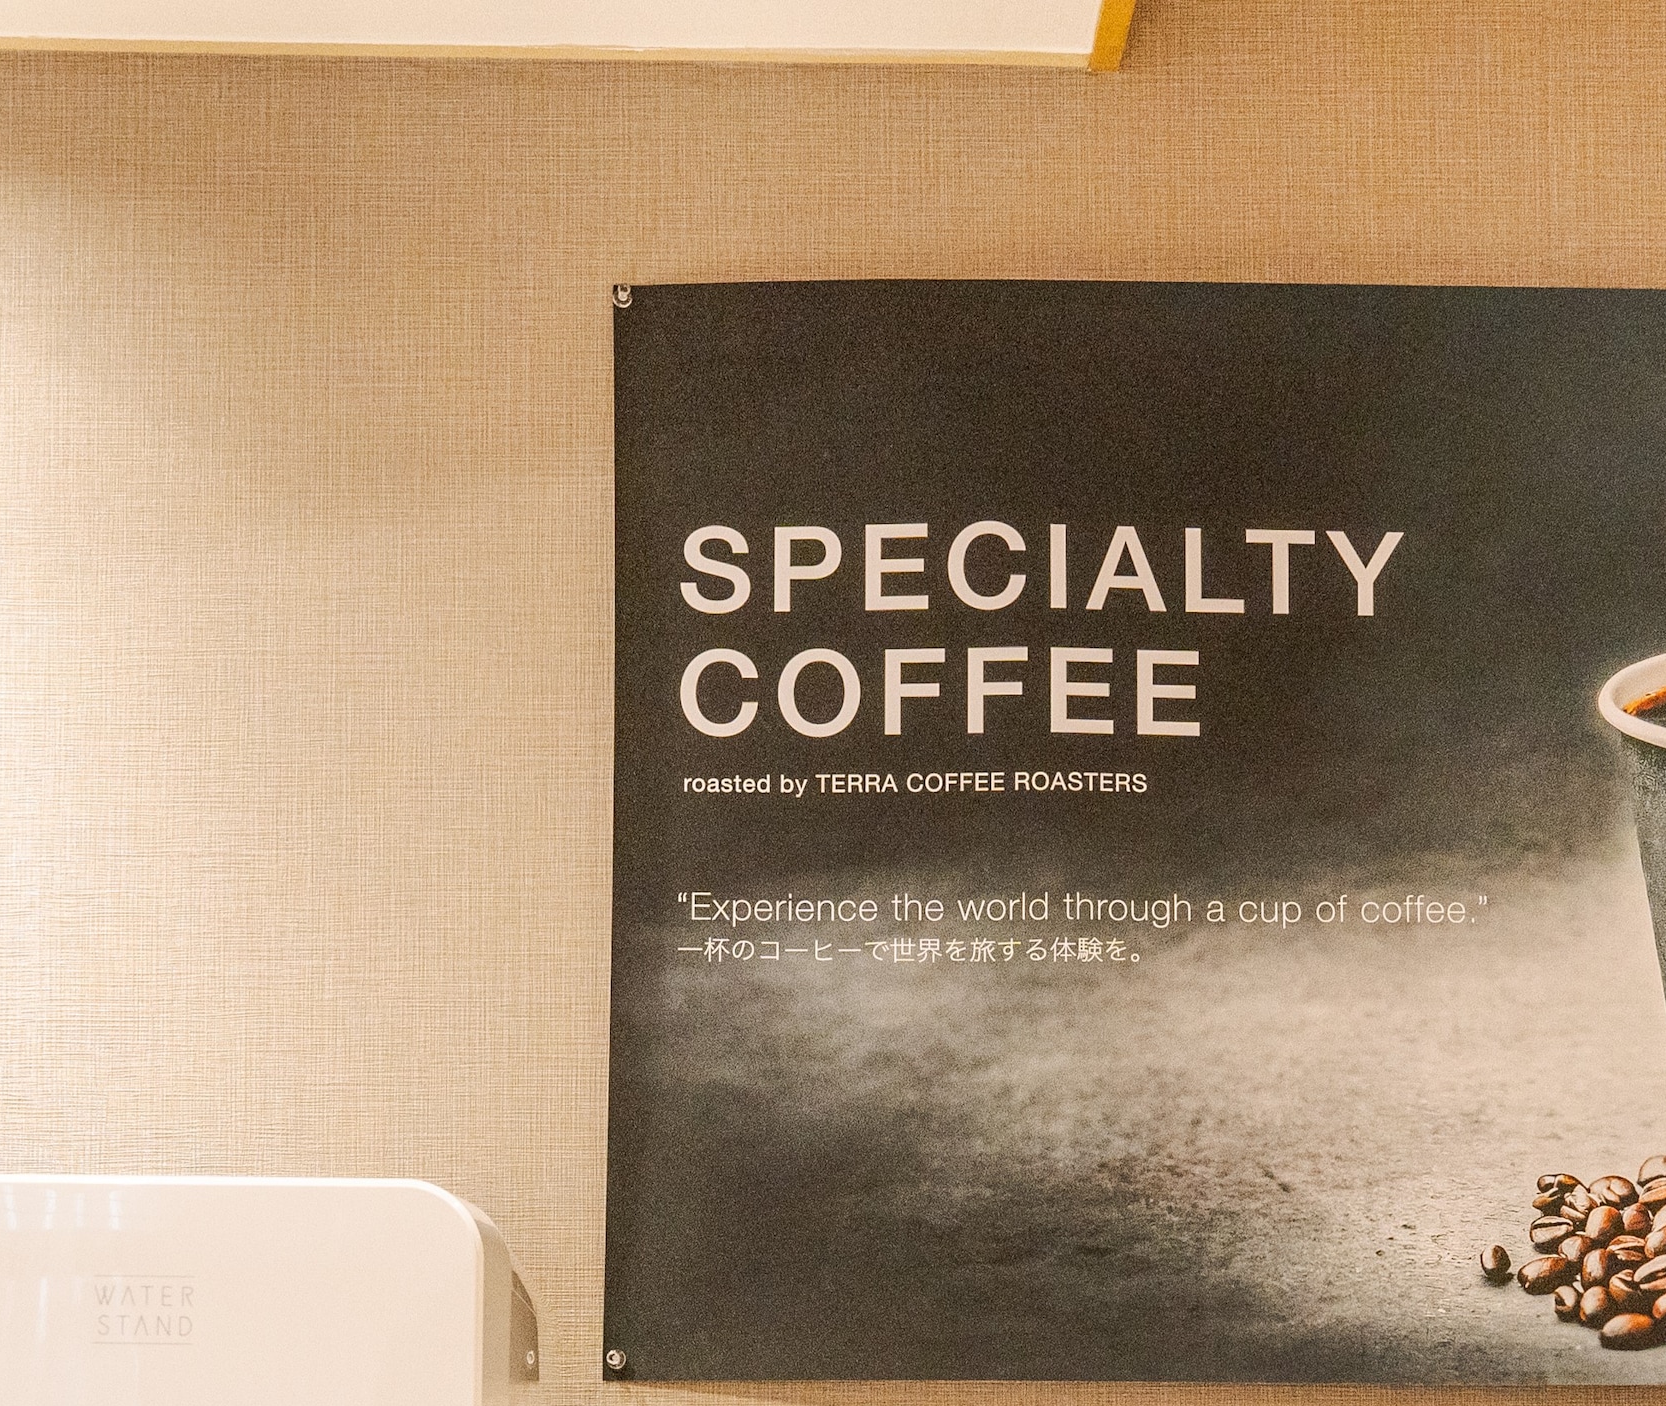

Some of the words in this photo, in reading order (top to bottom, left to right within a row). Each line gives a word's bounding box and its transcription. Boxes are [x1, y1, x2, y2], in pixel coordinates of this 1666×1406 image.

[679, 520, 1405, 617] SPECIALTY
[679, 646, 1201, 738] COFFEE
[683, 774, 771, 793] roasted
[779, 774, 808, 798] by
[815, 773, 898, 794] TERRA
[906, 771, 1006, 793] COFFEE
[1014, 771, 1148, 793] ROASTERS
[677, 891, 878, 928] “Experience
[891, 893, 945, 923] the
[958, 892, 1050, 923] world
[1063, 892, 1192, 929] through
[1206, 900, 1226, 923] a
[1238, 899, 1302, 930] cup
[1315, 895, 1348, 923] of
[1360, 894, 1489, 925] coffee.”
[677, 936, 1141, 964] 一杯のコーヒーで世界を旅する体験を。
[93, 1284, 195, 1308] WATER
[96, 1314, 194, 1337] STAND
